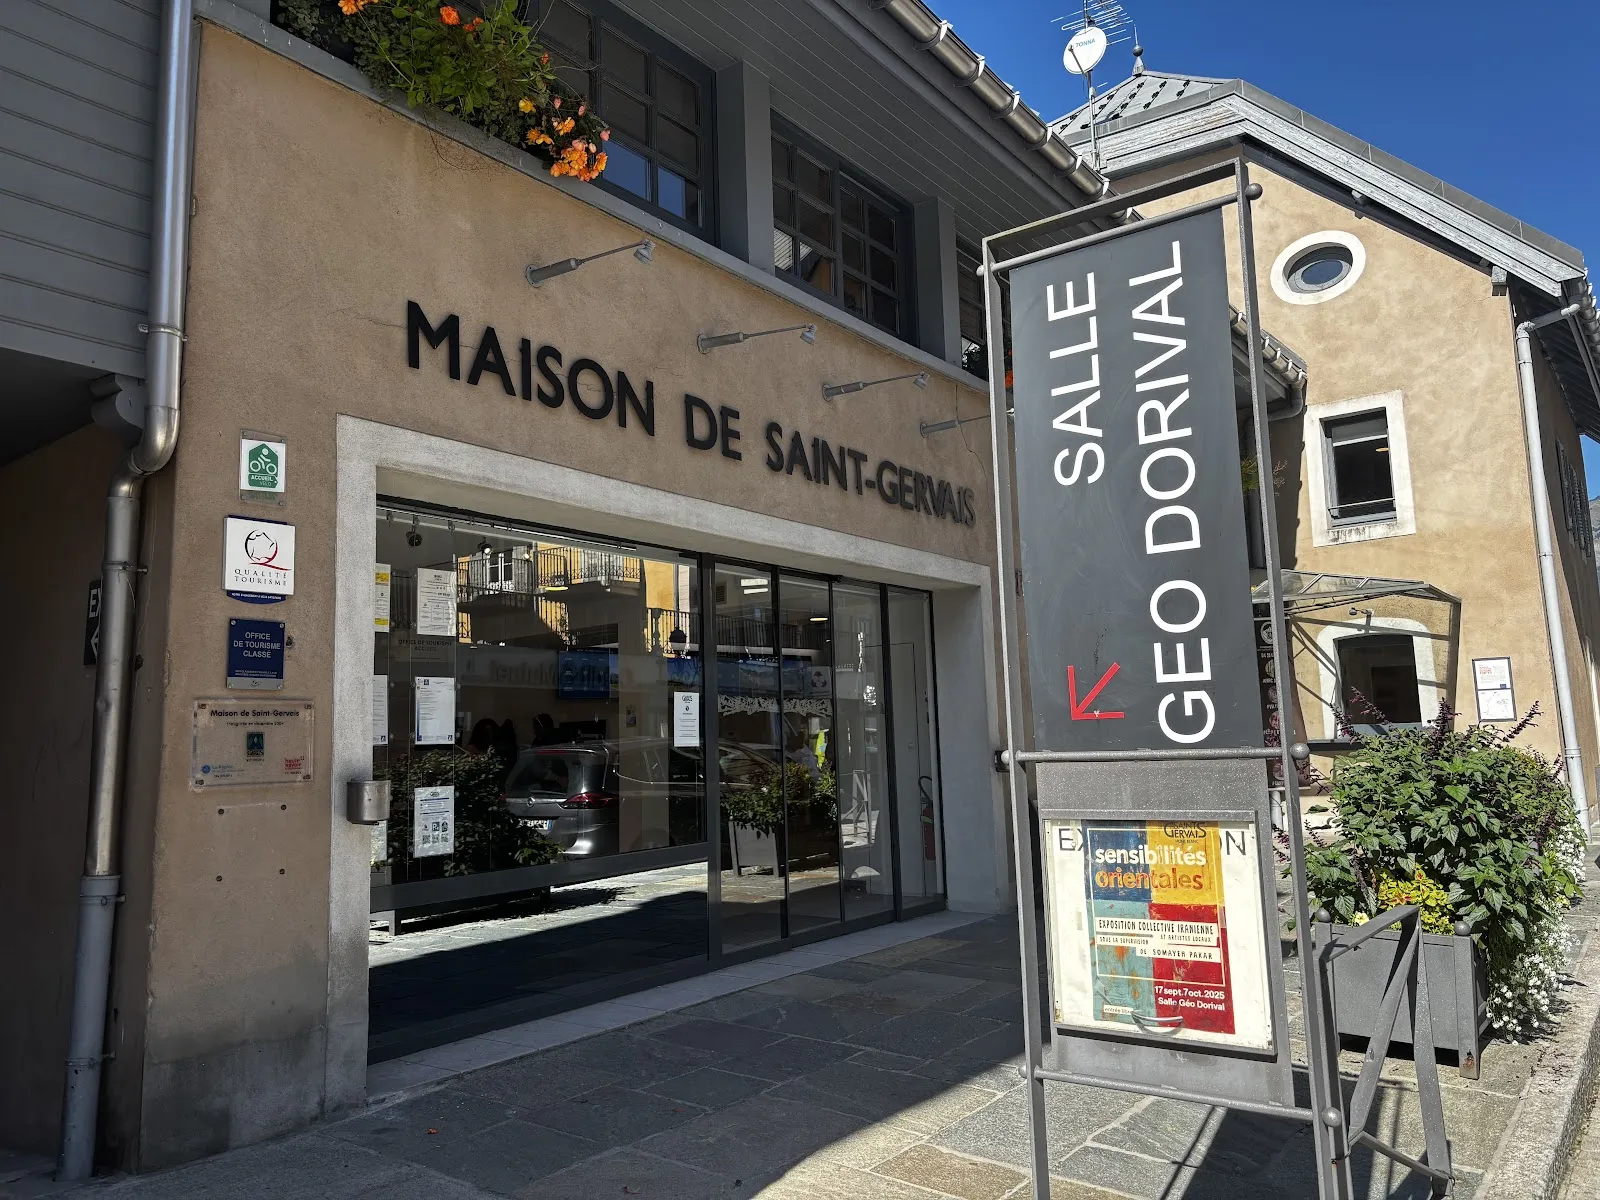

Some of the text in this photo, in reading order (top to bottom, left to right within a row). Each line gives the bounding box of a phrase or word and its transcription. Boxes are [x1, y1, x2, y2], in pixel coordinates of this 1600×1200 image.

[1075, 38, 1096, 48] TONNA
[1046, 271, 1105, 486] SALLE
[407, 299, 975, 528] MAISON DE SAINT-GERVAIS
[250, 474, 274, 482] ACCUEIL
[1128, 240, 1216, 744] GEO DORIVAL
[234, 568, 287, 579] QUALITÉ
[234, 576, 287, 587] TOURISME
[245, 631, 271, 641] OFFICE
[233, 640, 281, 650] DE TOURISME
[243, 650, 272, 659] CLASSÉ
[210, 709, 300, 718] Maison de Saint-Gervais
[1163, 821, 1207, 838] GERVAIS
[1095, 844, 1207, 866] sensibilités
[1095, 867, 1204, 891] orientales
[1098, 919, 1214, 935] EXPOSITION COLLECTIVE IRANIENNE
[1189, 951, 1213, 960] PAKAR
[1158, 996, 1225, 1011] Salle Géo Dorival
